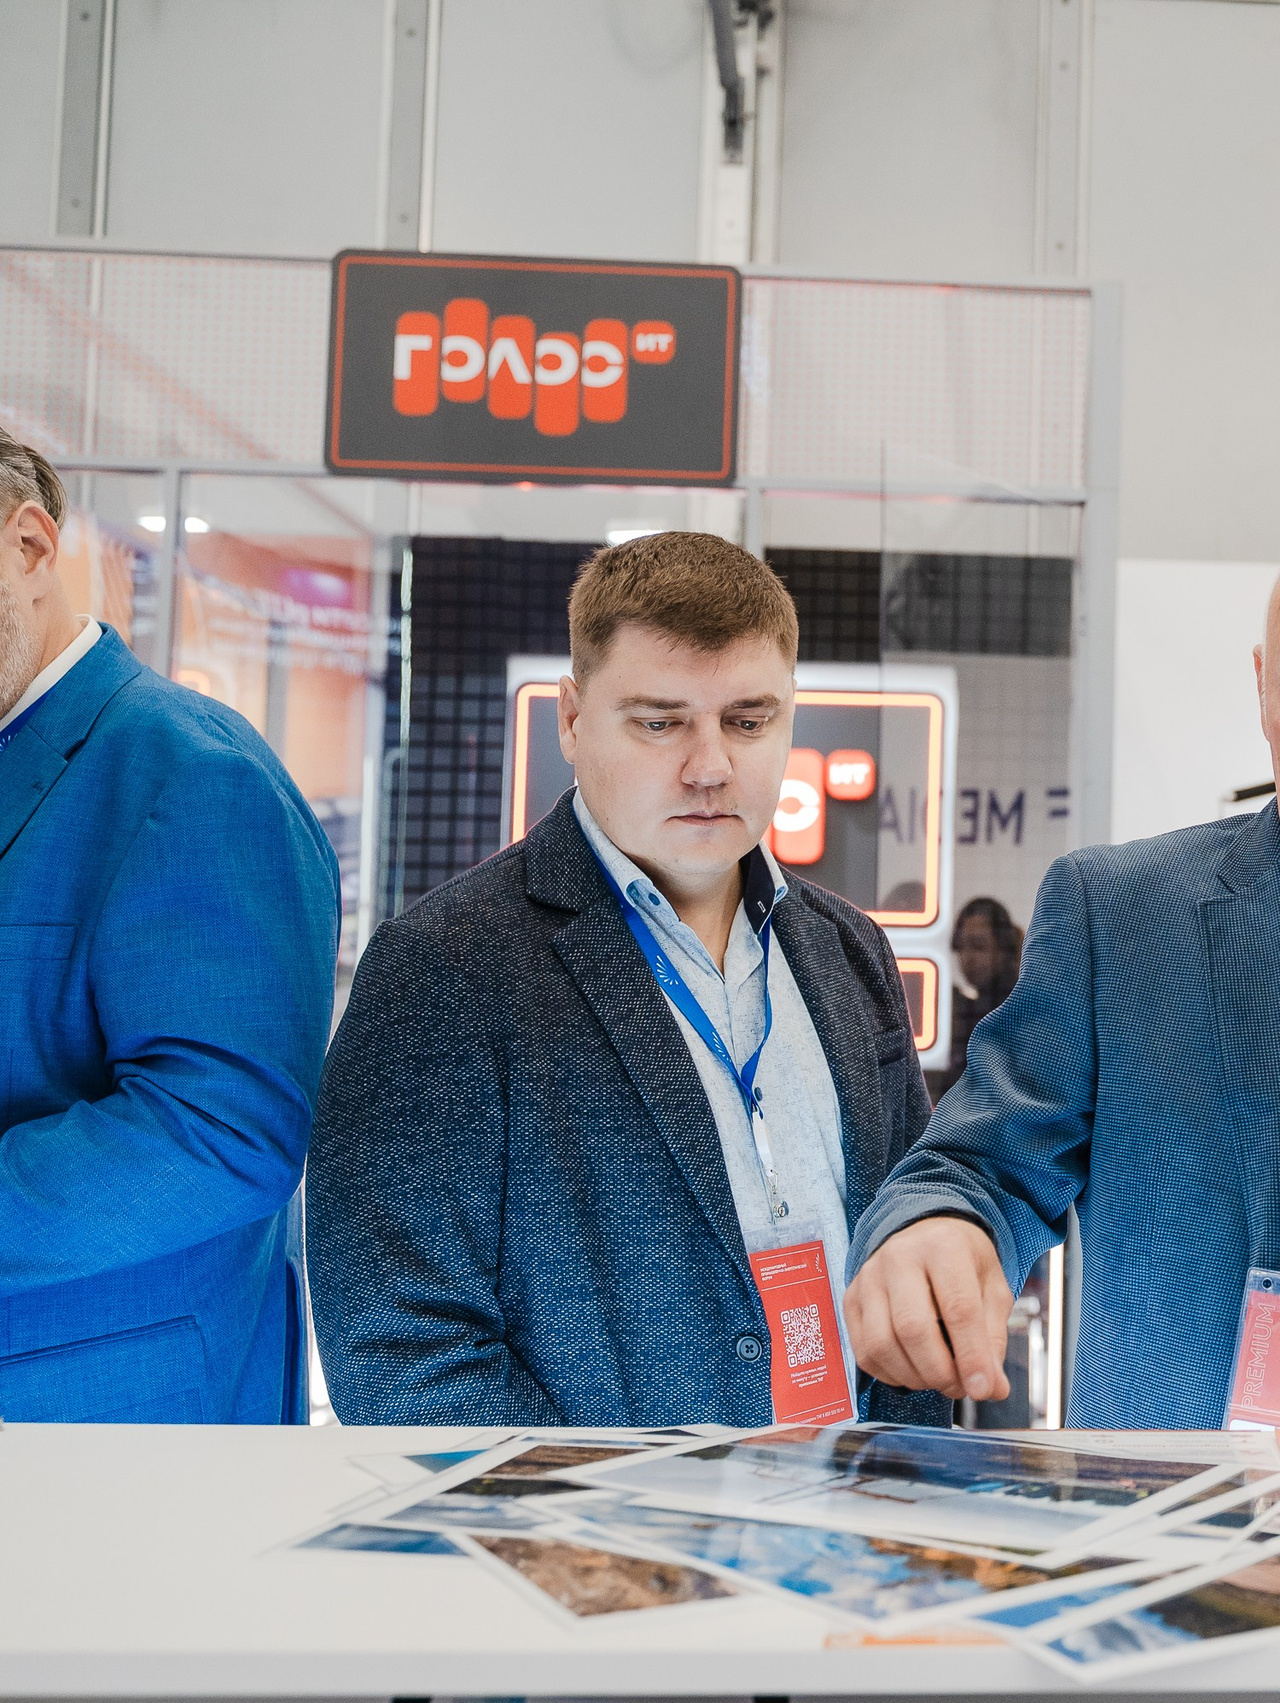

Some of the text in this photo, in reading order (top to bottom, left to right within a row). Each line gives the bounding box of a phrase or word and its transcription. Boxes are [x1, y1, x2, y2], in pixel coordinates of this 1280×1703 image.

[393, 333, 674, 388] ГОЛОС ИТ
[1241, 1302, 1276, 1411] PREMIUM
